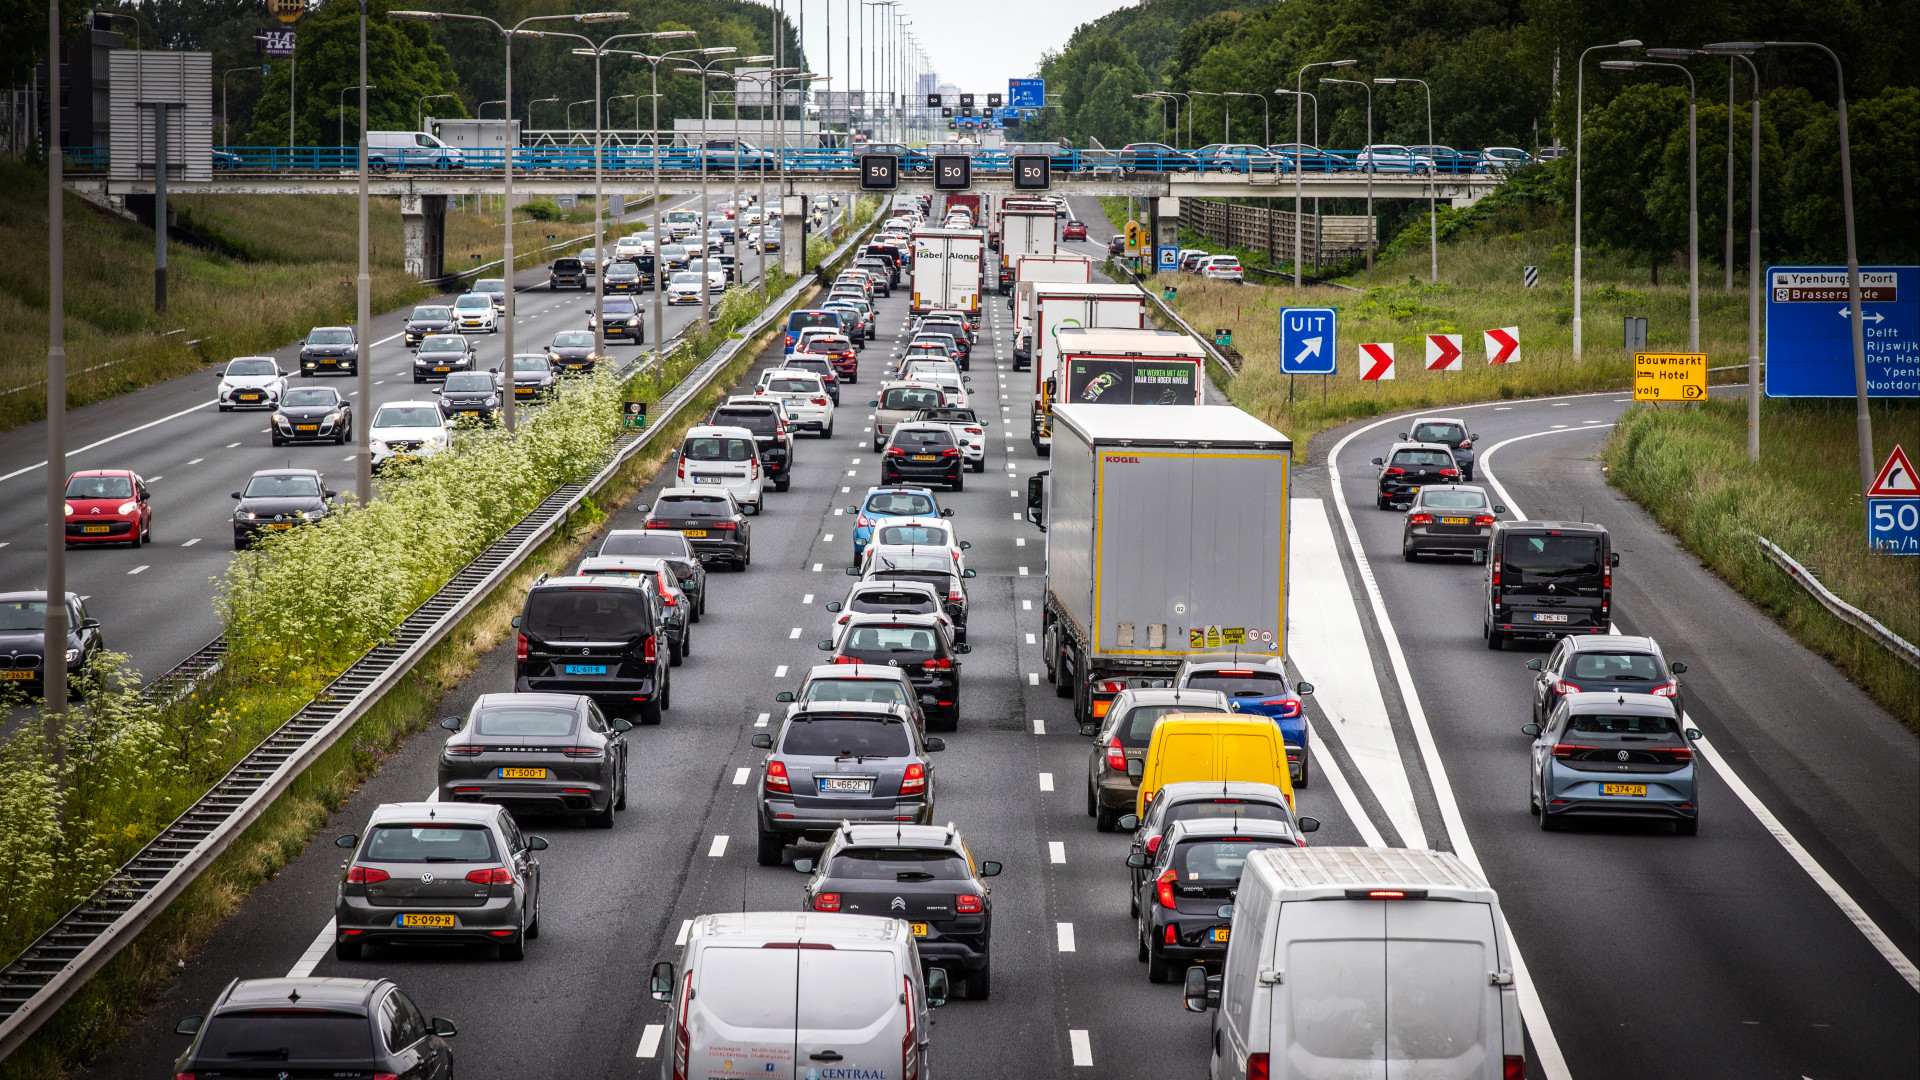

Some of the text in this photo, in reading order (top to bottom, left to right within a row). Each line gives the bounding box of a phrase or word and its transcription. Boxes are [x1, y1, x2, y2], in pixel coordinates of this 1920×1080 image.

[871, 167, 888, 177] 50
[944, 167, 961, 177] 50
[1024, 167, 1041, 177] 50
[916, 252, 980, 261] Isabel Alonso
[1863, 275, 1893, 283] Poort
[1291, 317, 1326, 332] UIT
[1867, 328, 1899, 338] Delft
[1867, 342, 1919, 354] Rijswijk
[1637, 355, 1702, 365] Bouwmarkt
[1867, 354, 1891, 364] Den
[1659, 371, 1689, 380] Hotel
[1637, 386, 1660, 397] volg
[1686, 386, 1695, 396] G
[1105, 456, 1140, 464] KÖGEL
[1875, 504, 1919, 531] 50
[1875, 536, 1918, 551] km/h
[505, 768, 544, 778] XT-500-T
[826, 780, 869, 790] BL 662FY
[1606, 784, 1643, 794] N-374-JR
[405, 914, 452, 926] TS-099-R
[821, 1068, 887, 1080] CENTRAAL
